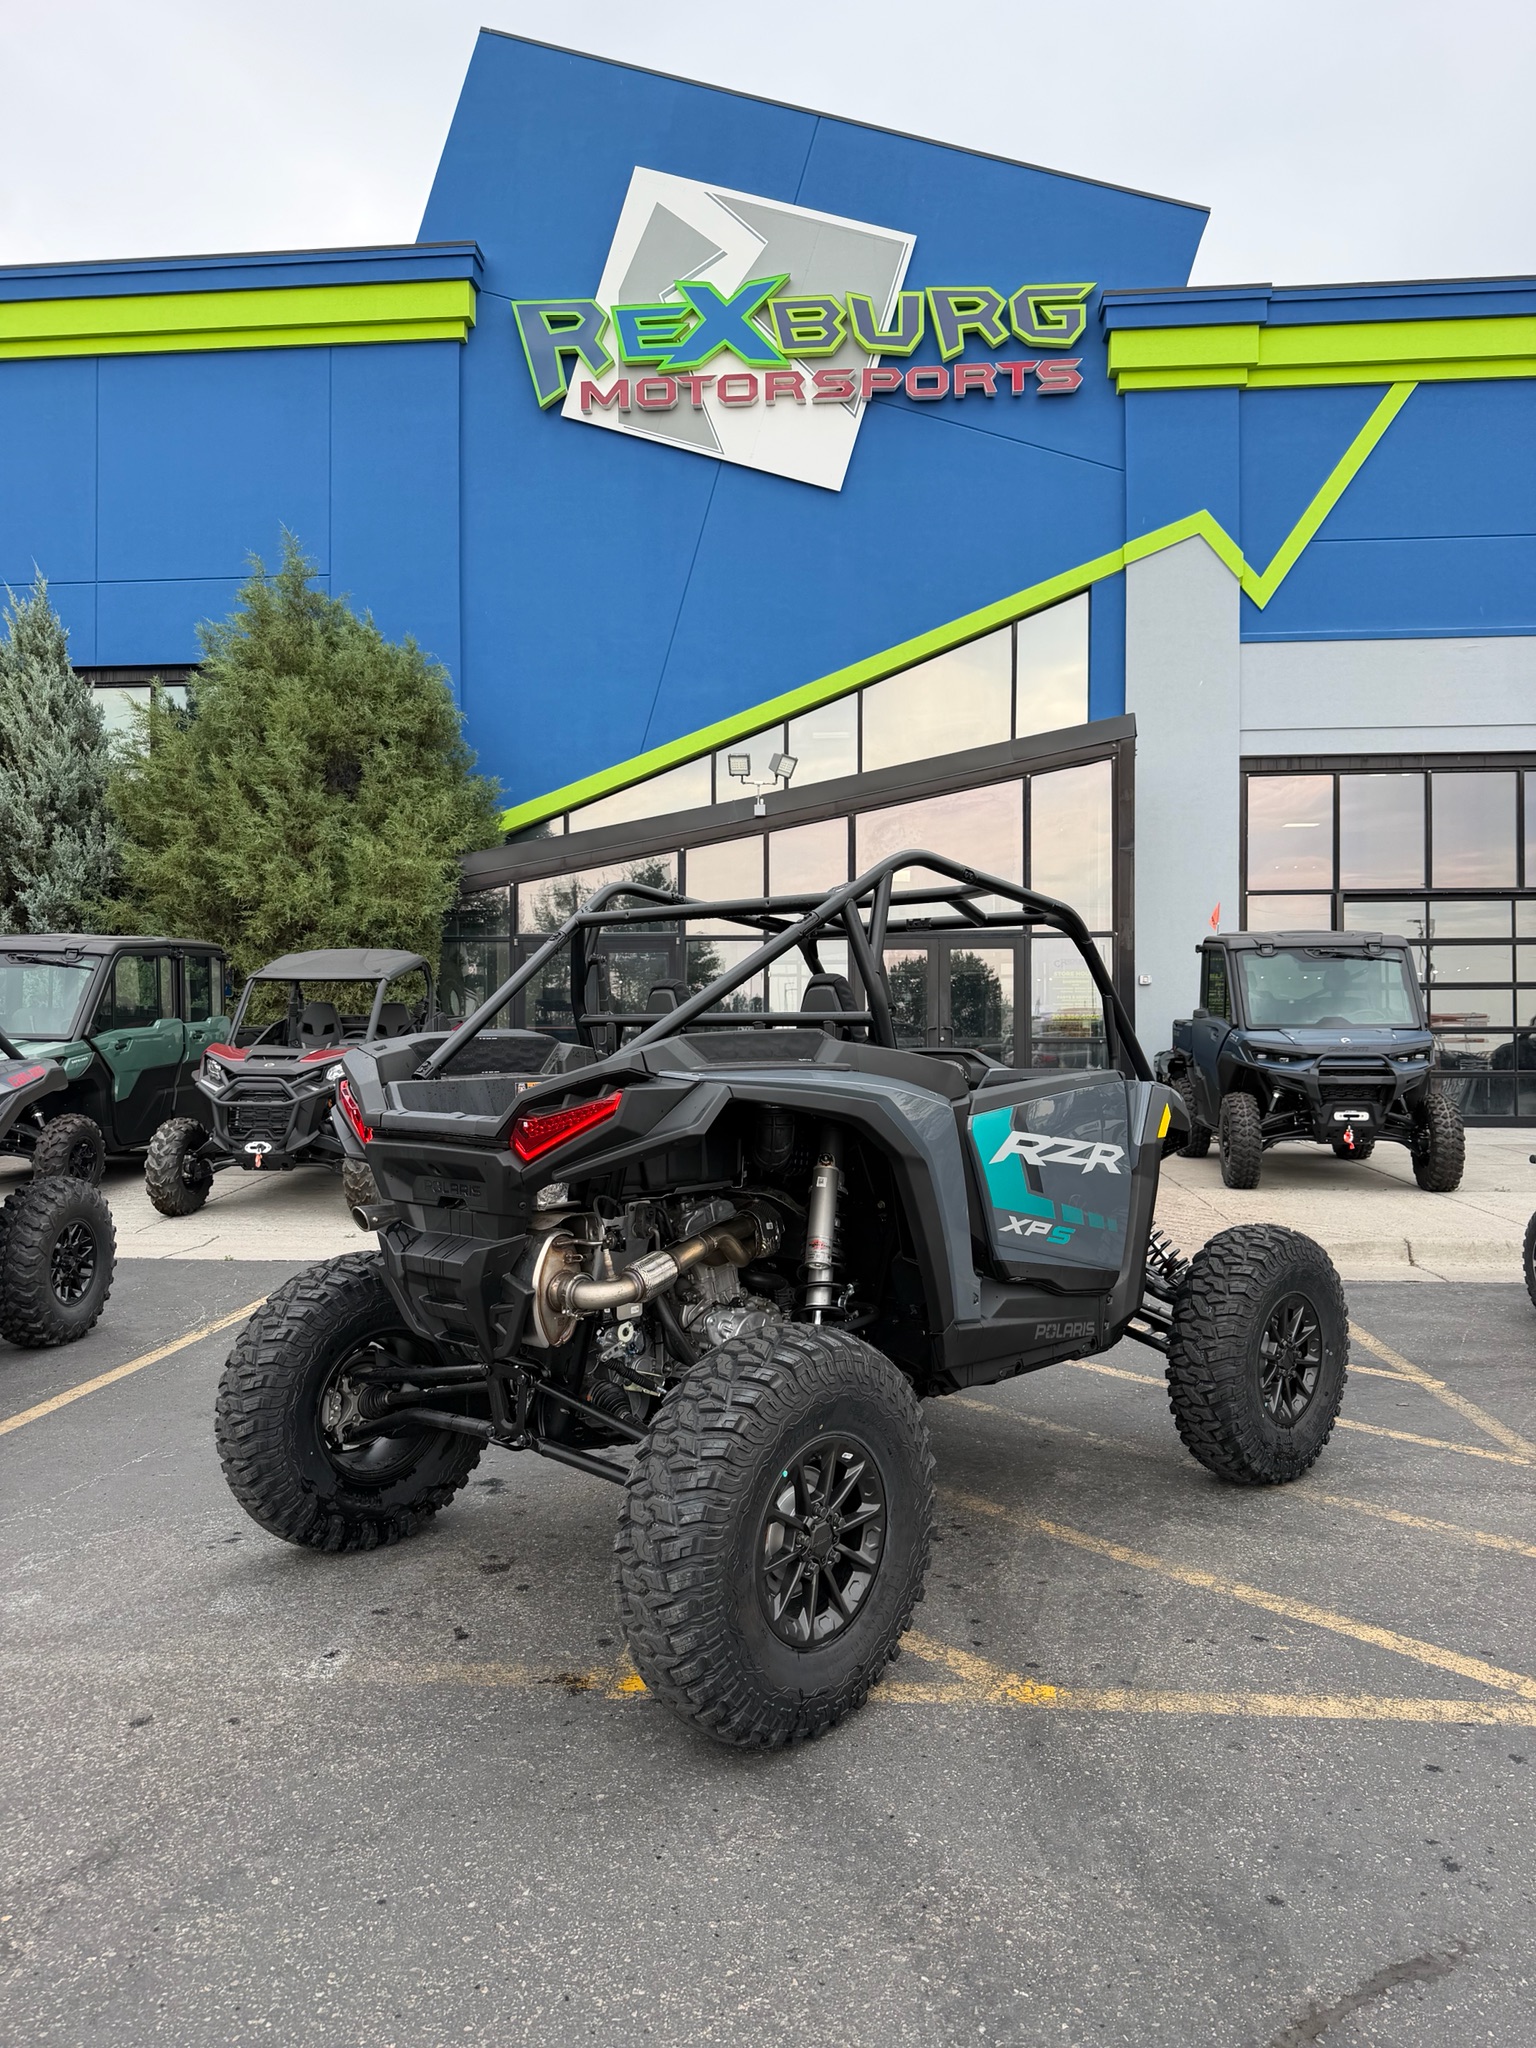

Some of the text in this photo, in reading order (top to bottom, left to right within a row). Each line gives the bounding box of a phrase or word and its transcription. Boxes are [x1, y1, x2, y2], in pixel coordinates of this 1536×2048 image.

[511, 273, 1097, 410] REXBURG
[580, 358, 1084, 415] MOTORSPORTS
[989, 1130, 1126, 1175] RZR
[424, 1179, 482, 1198] POLARIS
[1034, 1321, 1096, 1341] POLARIS
